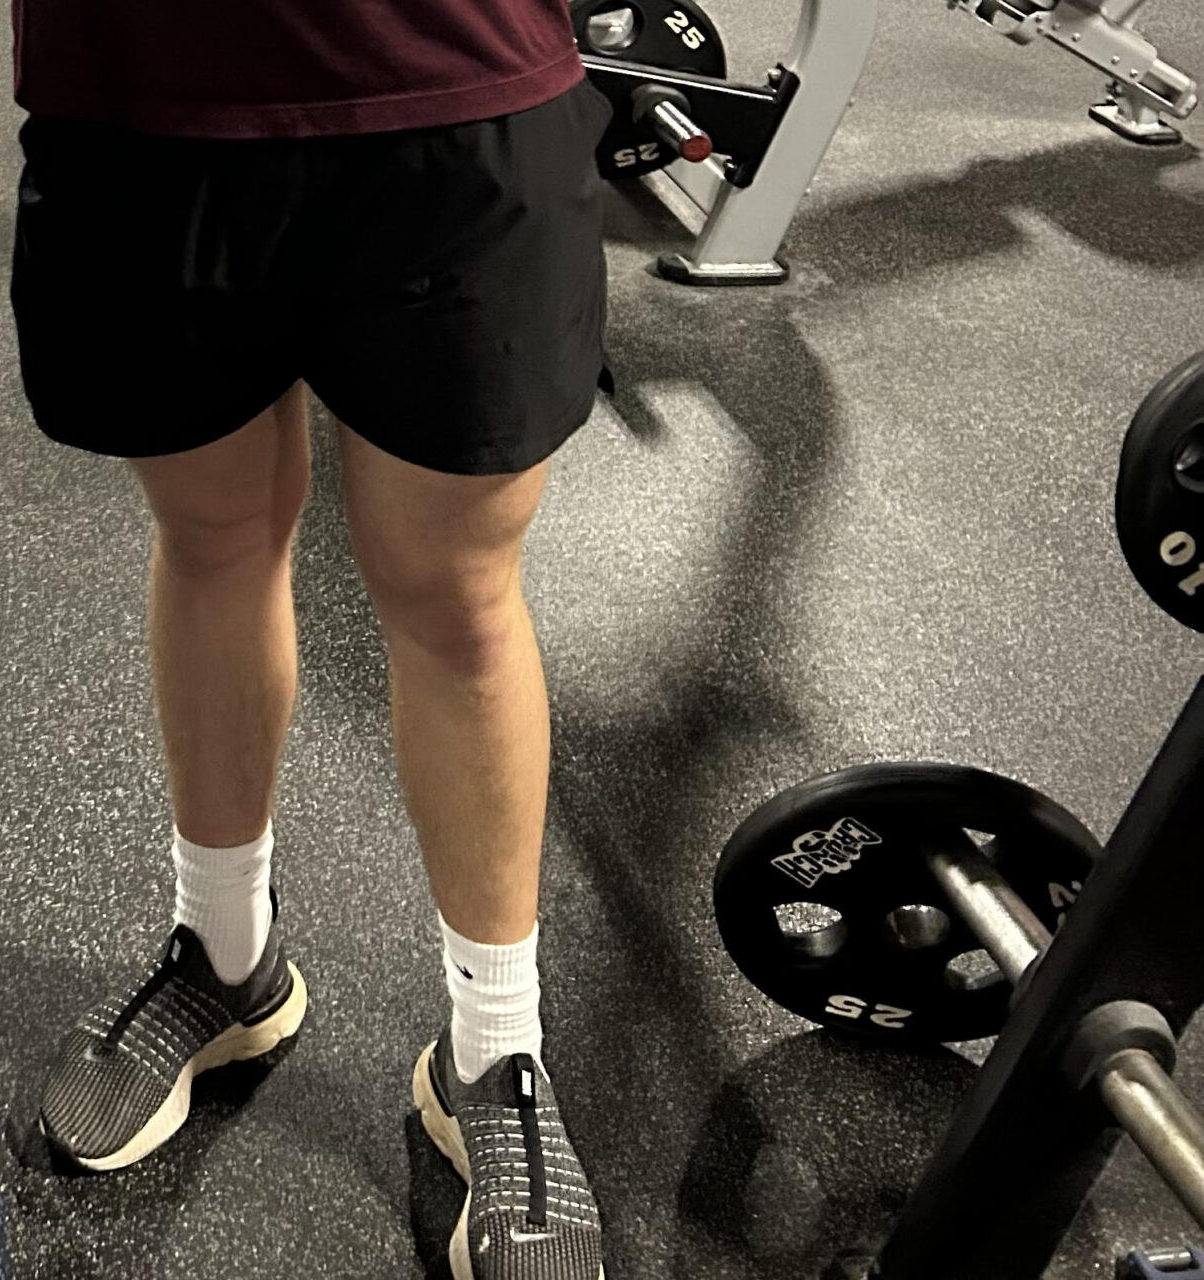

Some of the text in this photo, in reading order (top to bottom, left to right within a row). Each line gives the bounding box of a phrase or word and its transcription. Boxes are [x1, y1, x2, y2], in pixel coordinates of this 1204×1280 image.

[664, 10, 706, 49] 25
[613, 142, 660, 168] 25
[771, 817, 882, 887] CRUNCH
[825, 994, 913, 1028] 25
